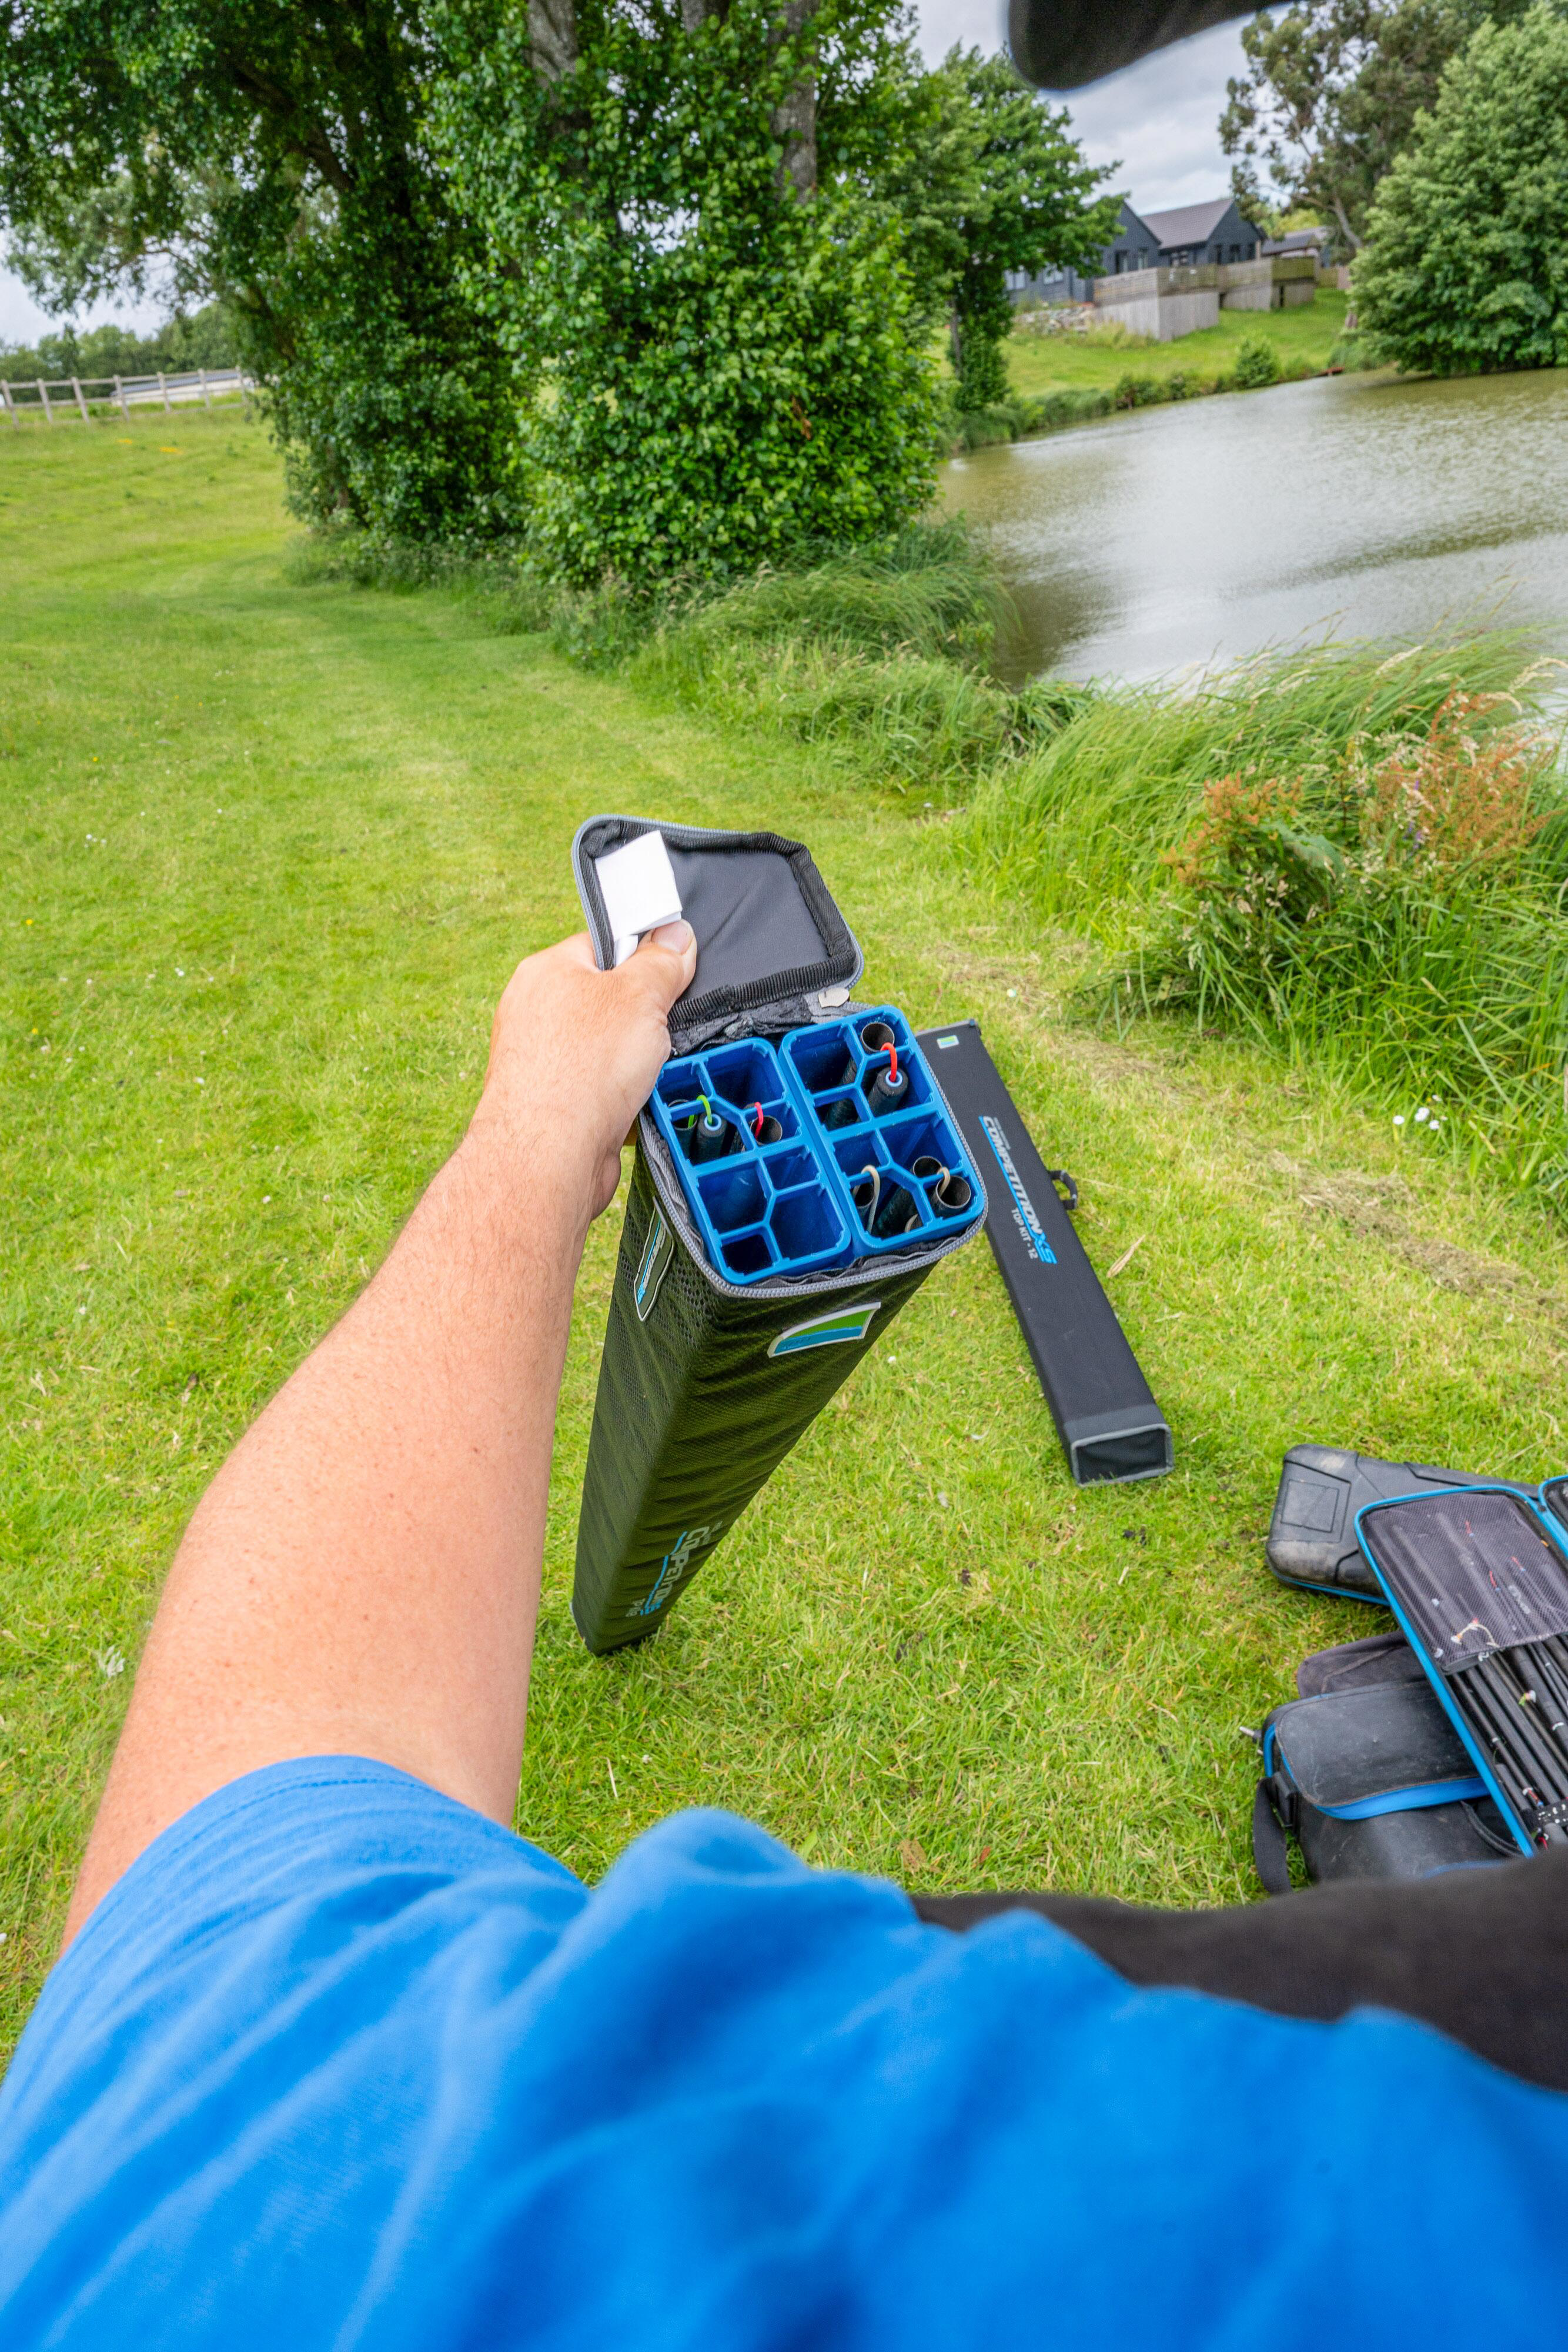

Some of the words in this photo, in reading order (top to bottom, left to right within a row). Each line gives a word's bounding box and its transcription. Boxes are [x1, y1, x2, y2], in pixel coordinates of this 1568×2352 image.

[983, 1115, 1044, 1235] COMPETITION
[1011, 1207, 1024, 1228] TOP
[1019, 1225, 1032, 1242] KIT
[1028, 1248, 1038, 1259] 12
